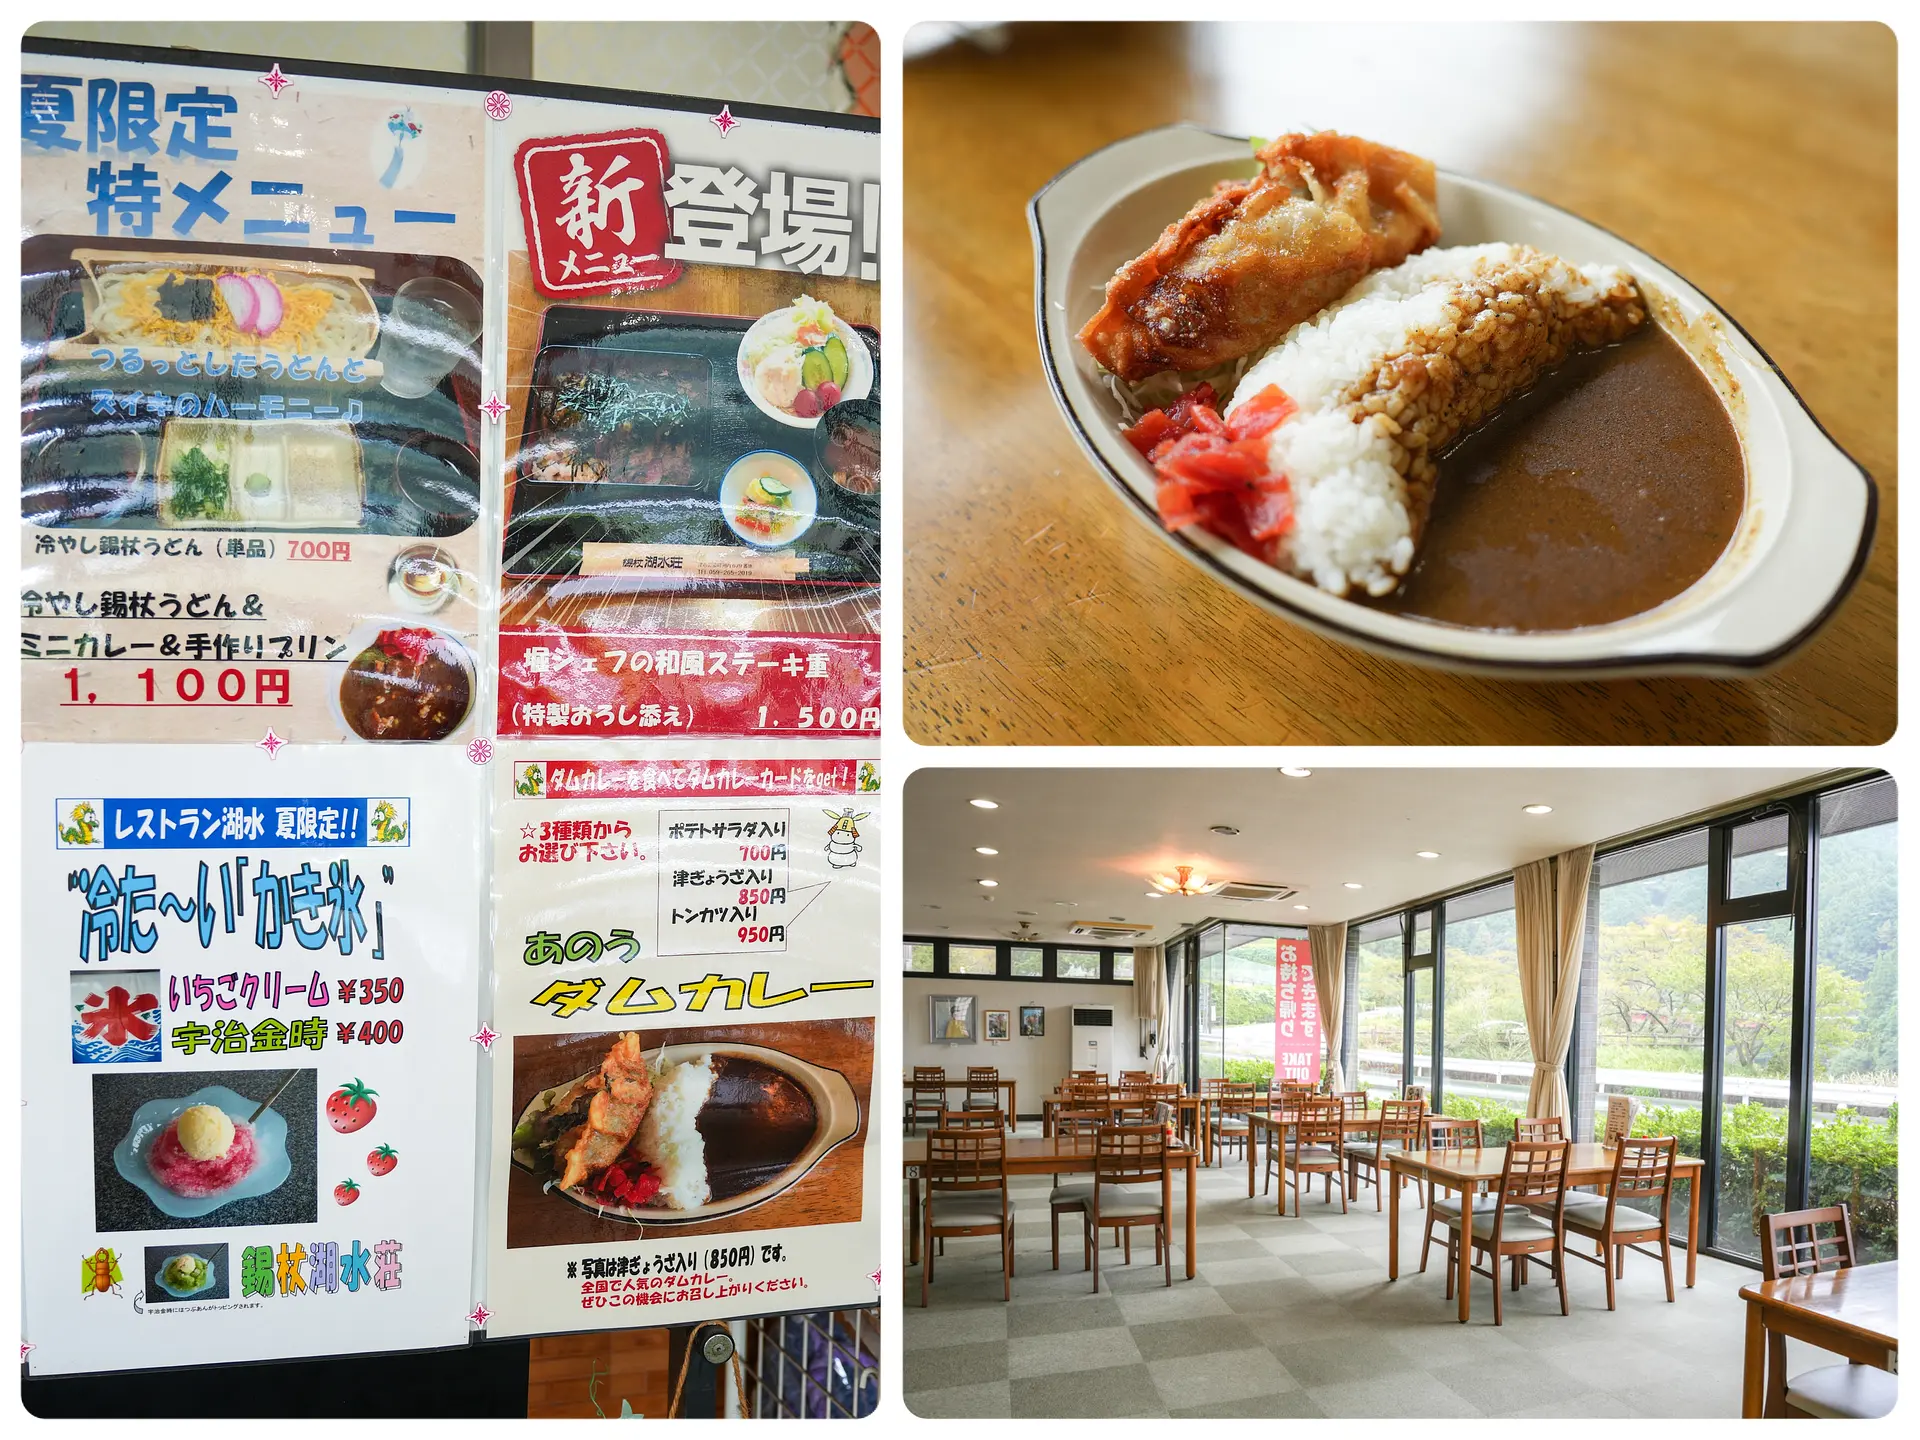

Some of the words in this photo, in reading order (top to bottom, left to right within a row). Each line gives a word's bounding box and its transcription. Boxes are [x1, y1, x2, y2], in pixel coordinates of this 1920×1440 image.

[86, 161, 456, 246] 特メニュー
[555, 152, 645, 249] 新
[558, 250, 660, 281] メニュー
[91, 347, 367, 384] つるっとしたうどんと
[288, 539, 351, 560] 700円
[524, 647, 830, 680] 堀シェフの和風ステーキ重
[114, 806, 266, 841] レストラン湖水
[275, 806, 358, 840] 夏限定!!
[668, 821, 787, 840] ポテトサラダ入り
[518, 841, 647, 864] お選び下さい。
[739, 843, 787, 861] 700円
[672, 868, 773, 888] 津ぎょうざ入り
[738, 887, 786, 905] 850円
[671, 905, 758, 925] トンカツ入り
[523, 928, 642, 966] あのう
[737, 924, 786, 943] 950円
[168, 970, 330, 1012] いちごクリーム
[529, 970, 875, 1019] ダムカレー
[81, 985, 159, 1046] 氷
[171, 1016, 329, 1056] 宇治金時
[909, 1166, 918, 1178] 8
[240, 1238, 403, 1299] 錫杖湖水荘
[580, 1273, 734, 1296] 全国で人気のダムカレー。
[580, 1276, 809, 1309] ぜひこの機会にお召し上がりください。
